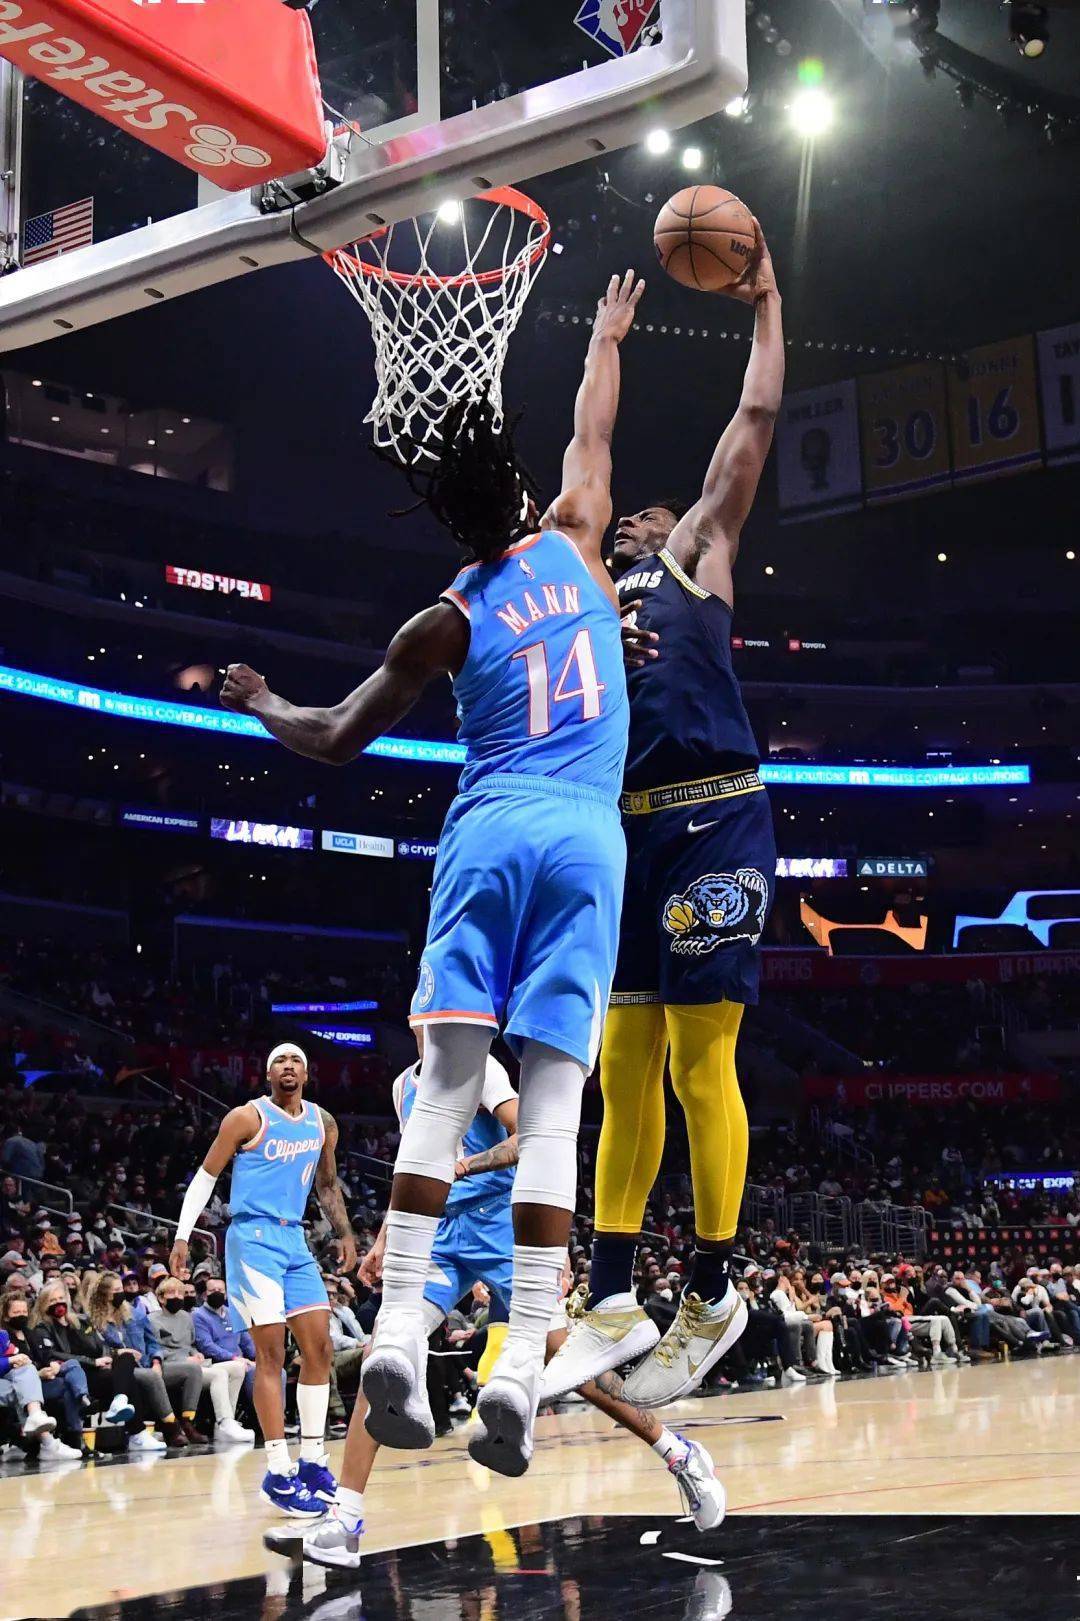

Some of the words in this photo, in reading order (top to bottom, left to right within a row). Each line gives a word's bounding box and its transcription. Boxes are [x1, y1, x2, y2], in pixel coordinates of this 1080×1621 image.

[967, 384, 1021, 448] 16
[871, 408, 937, 470] 30
[173, 566, 264, 601] TOSHIBA
[615, 569, 664, 596] PHIS
[497, 584, 580, 636] MANN
[510, 628, 606, 736] 14
[155, 707, 220, 729] COVERAGE
[123, 812, 163, 825] AMERICAN
[164, 816, 198, 828] EXPRESS
[334, 837, 355, 848] UCLA
[359, 839, 387, 852] Health
[876, 862, 924, 875] DELTA
[335, 1031, 372, 1042] EXPRESS
[264, 1138, 320, 1163] Clippers
[301, 1161, 315, 1187] 0
